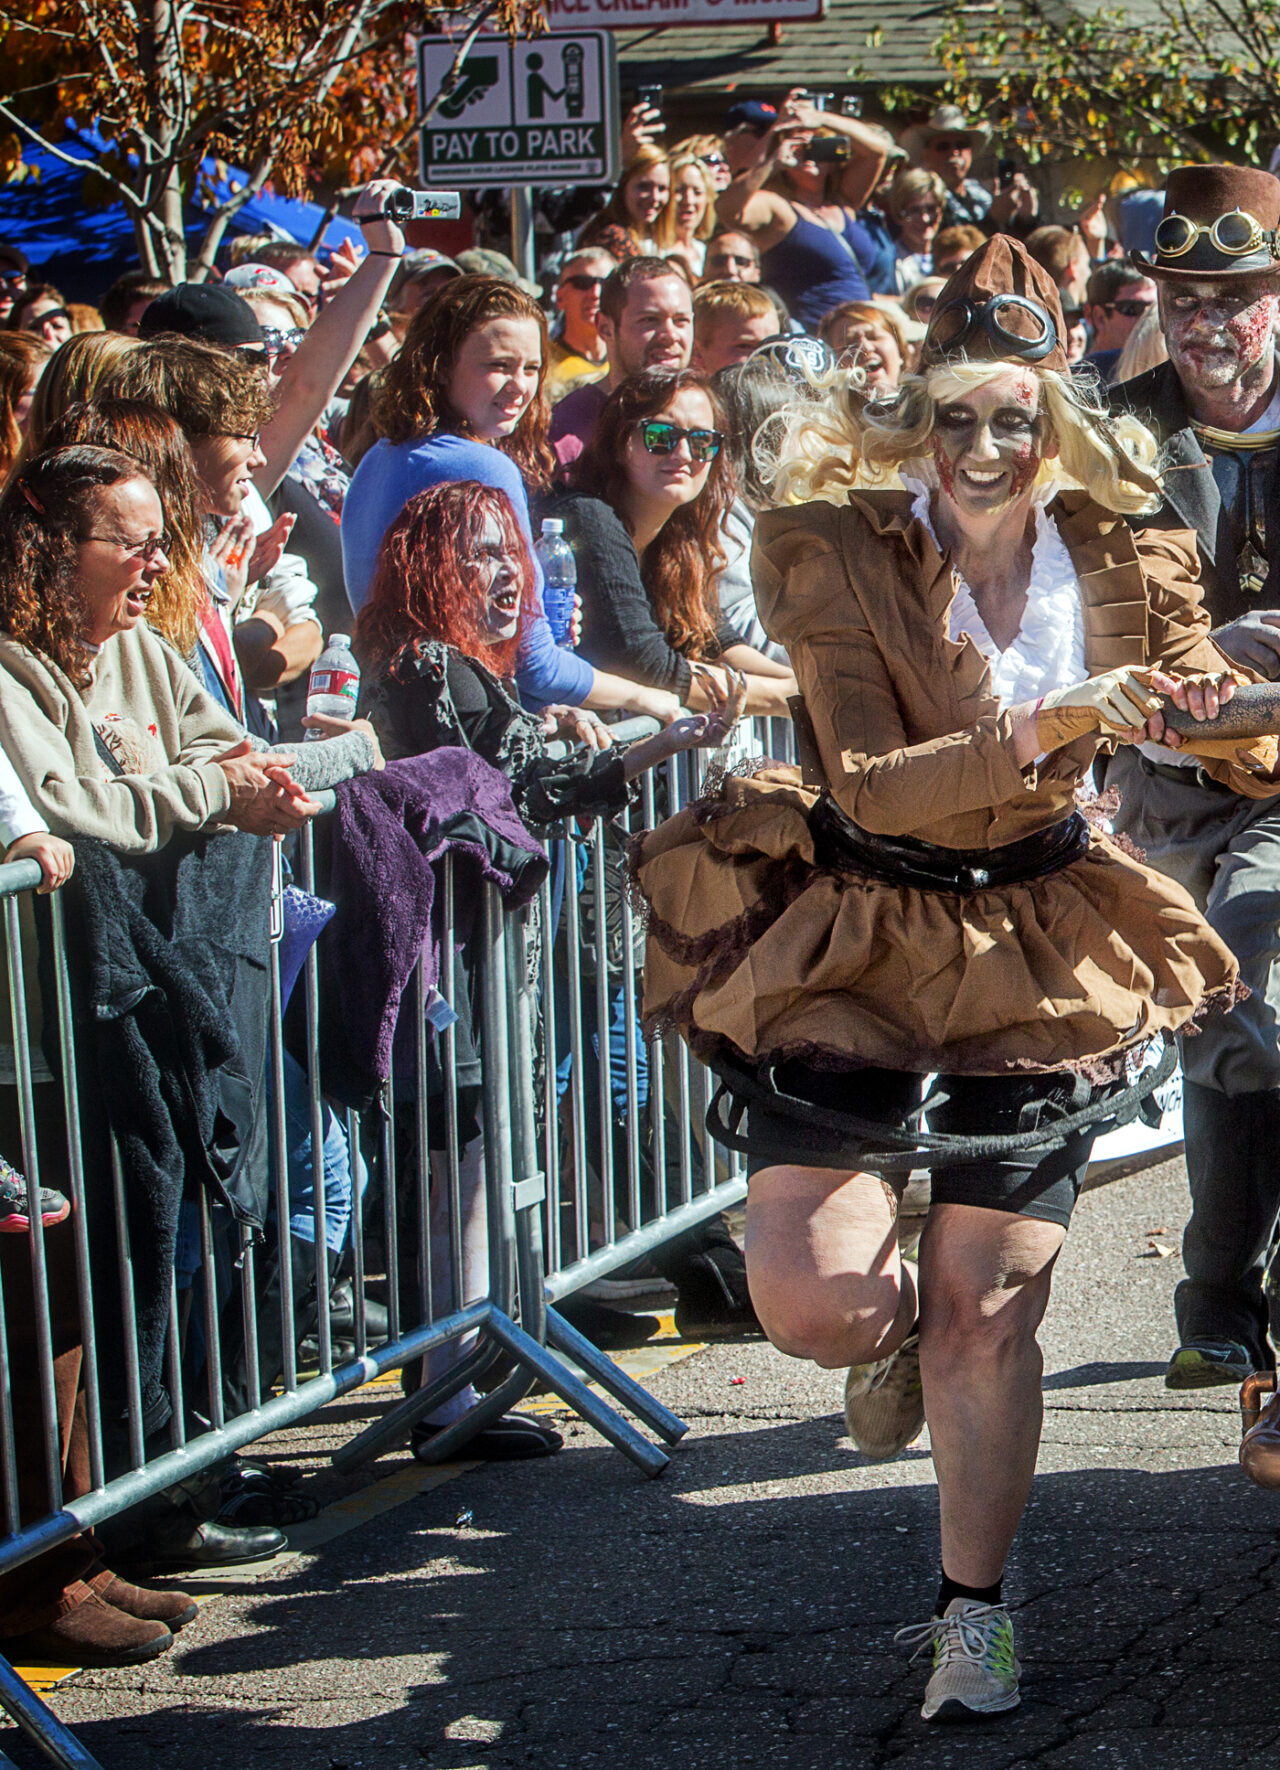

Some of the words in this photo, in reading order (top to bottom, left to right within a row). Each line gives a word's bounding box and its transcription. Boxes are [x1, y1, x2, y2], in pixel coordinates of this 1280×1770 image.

[431, 132, 479, 160] PAY
[485, 130, 520, 158] TO
[527, 127, 596, 157] PARK
